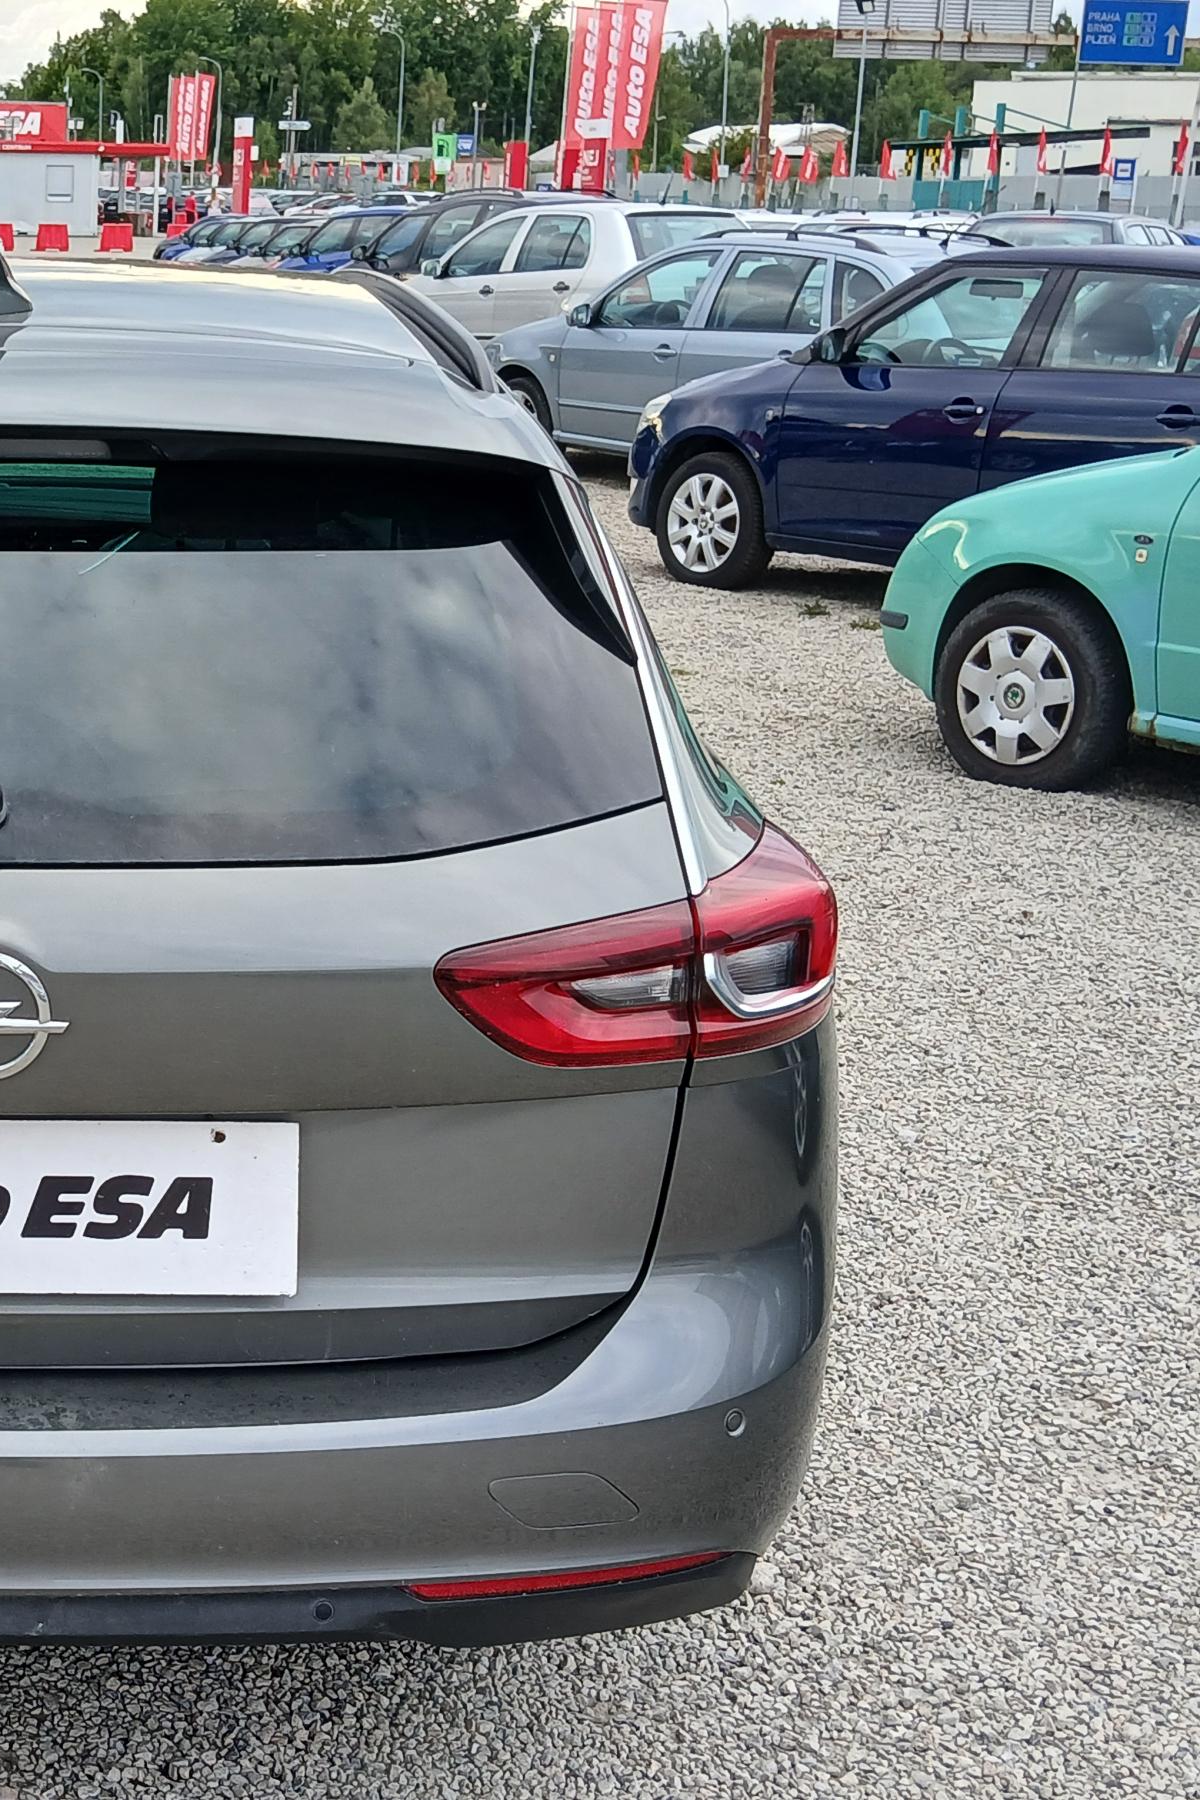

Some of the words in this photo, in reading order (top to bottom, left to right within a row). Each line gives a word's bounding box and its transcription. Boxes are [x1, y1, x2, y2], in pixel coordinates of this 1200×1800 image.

[630, 8, 653, 65] ESA
[1086, 23, 1114, 33] BRNO
[1088, 12, 1120, 21] PRAHA
[624, 65, 645, 138] Auto
[20, 1175, 213, 1239] ESA
